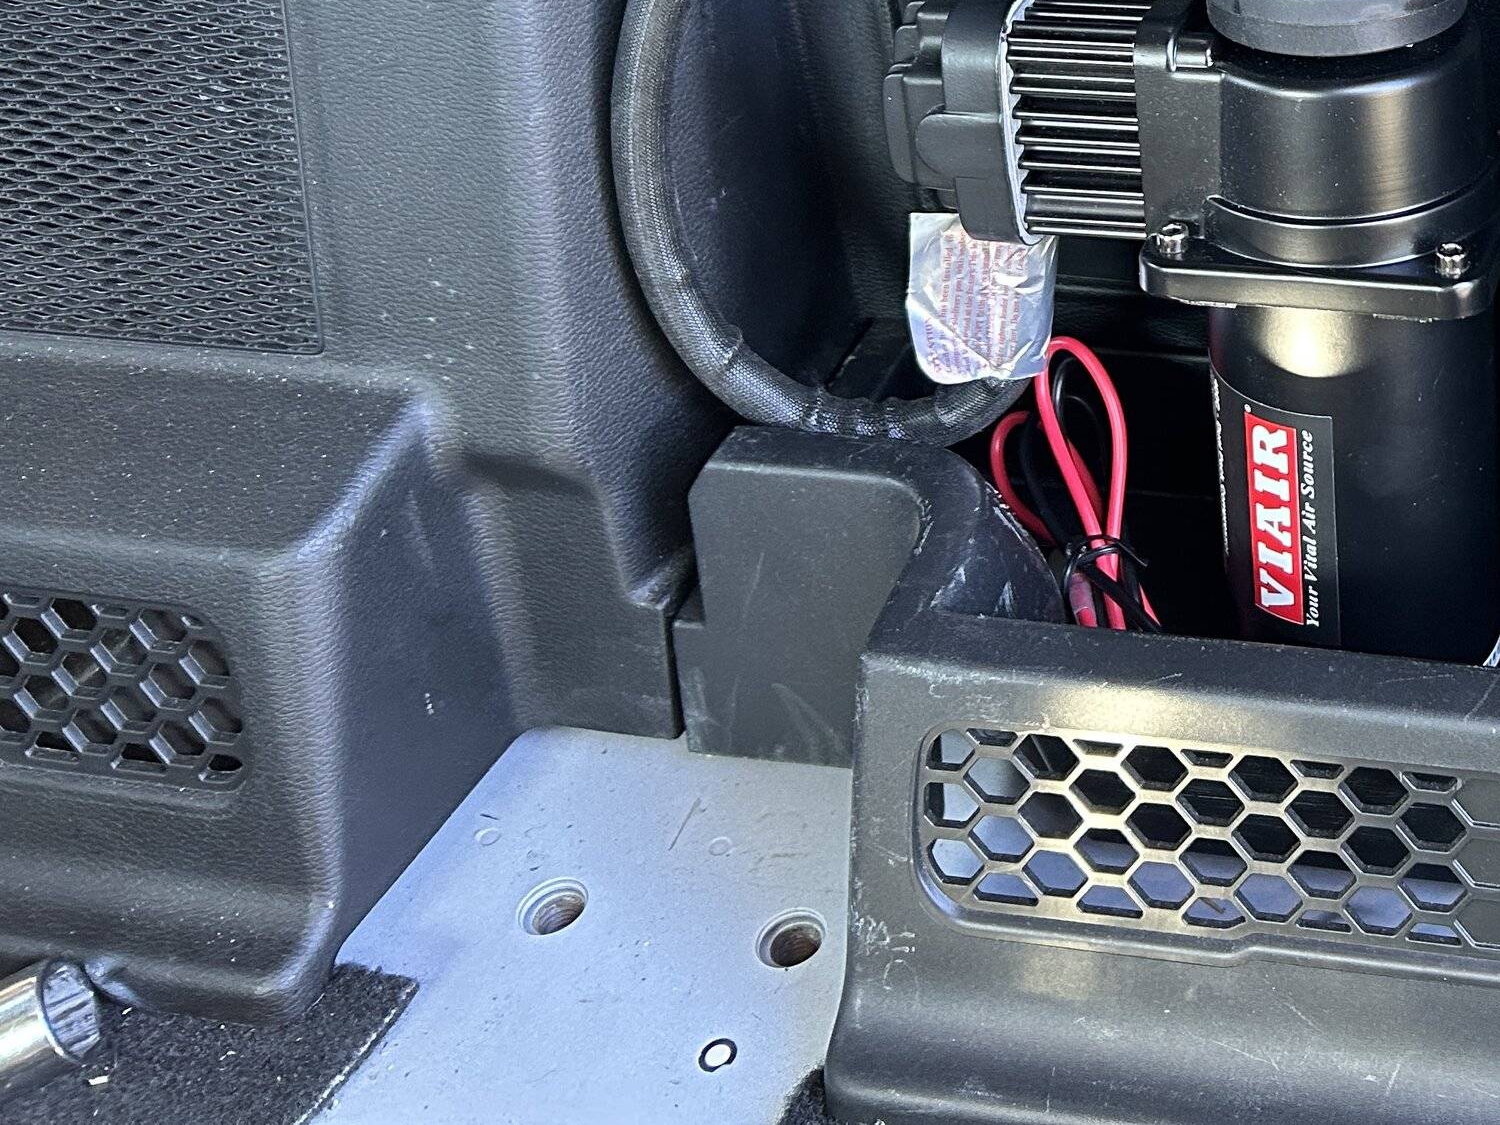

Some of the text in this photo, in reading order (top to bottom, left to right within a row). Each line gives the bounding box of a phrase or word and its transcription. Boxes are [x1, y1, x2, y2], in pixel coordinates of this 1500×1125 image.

[1252, 425, 1295, 609] VIAIR
[1301, 430, 1320, 627] Your Vital Air Source
